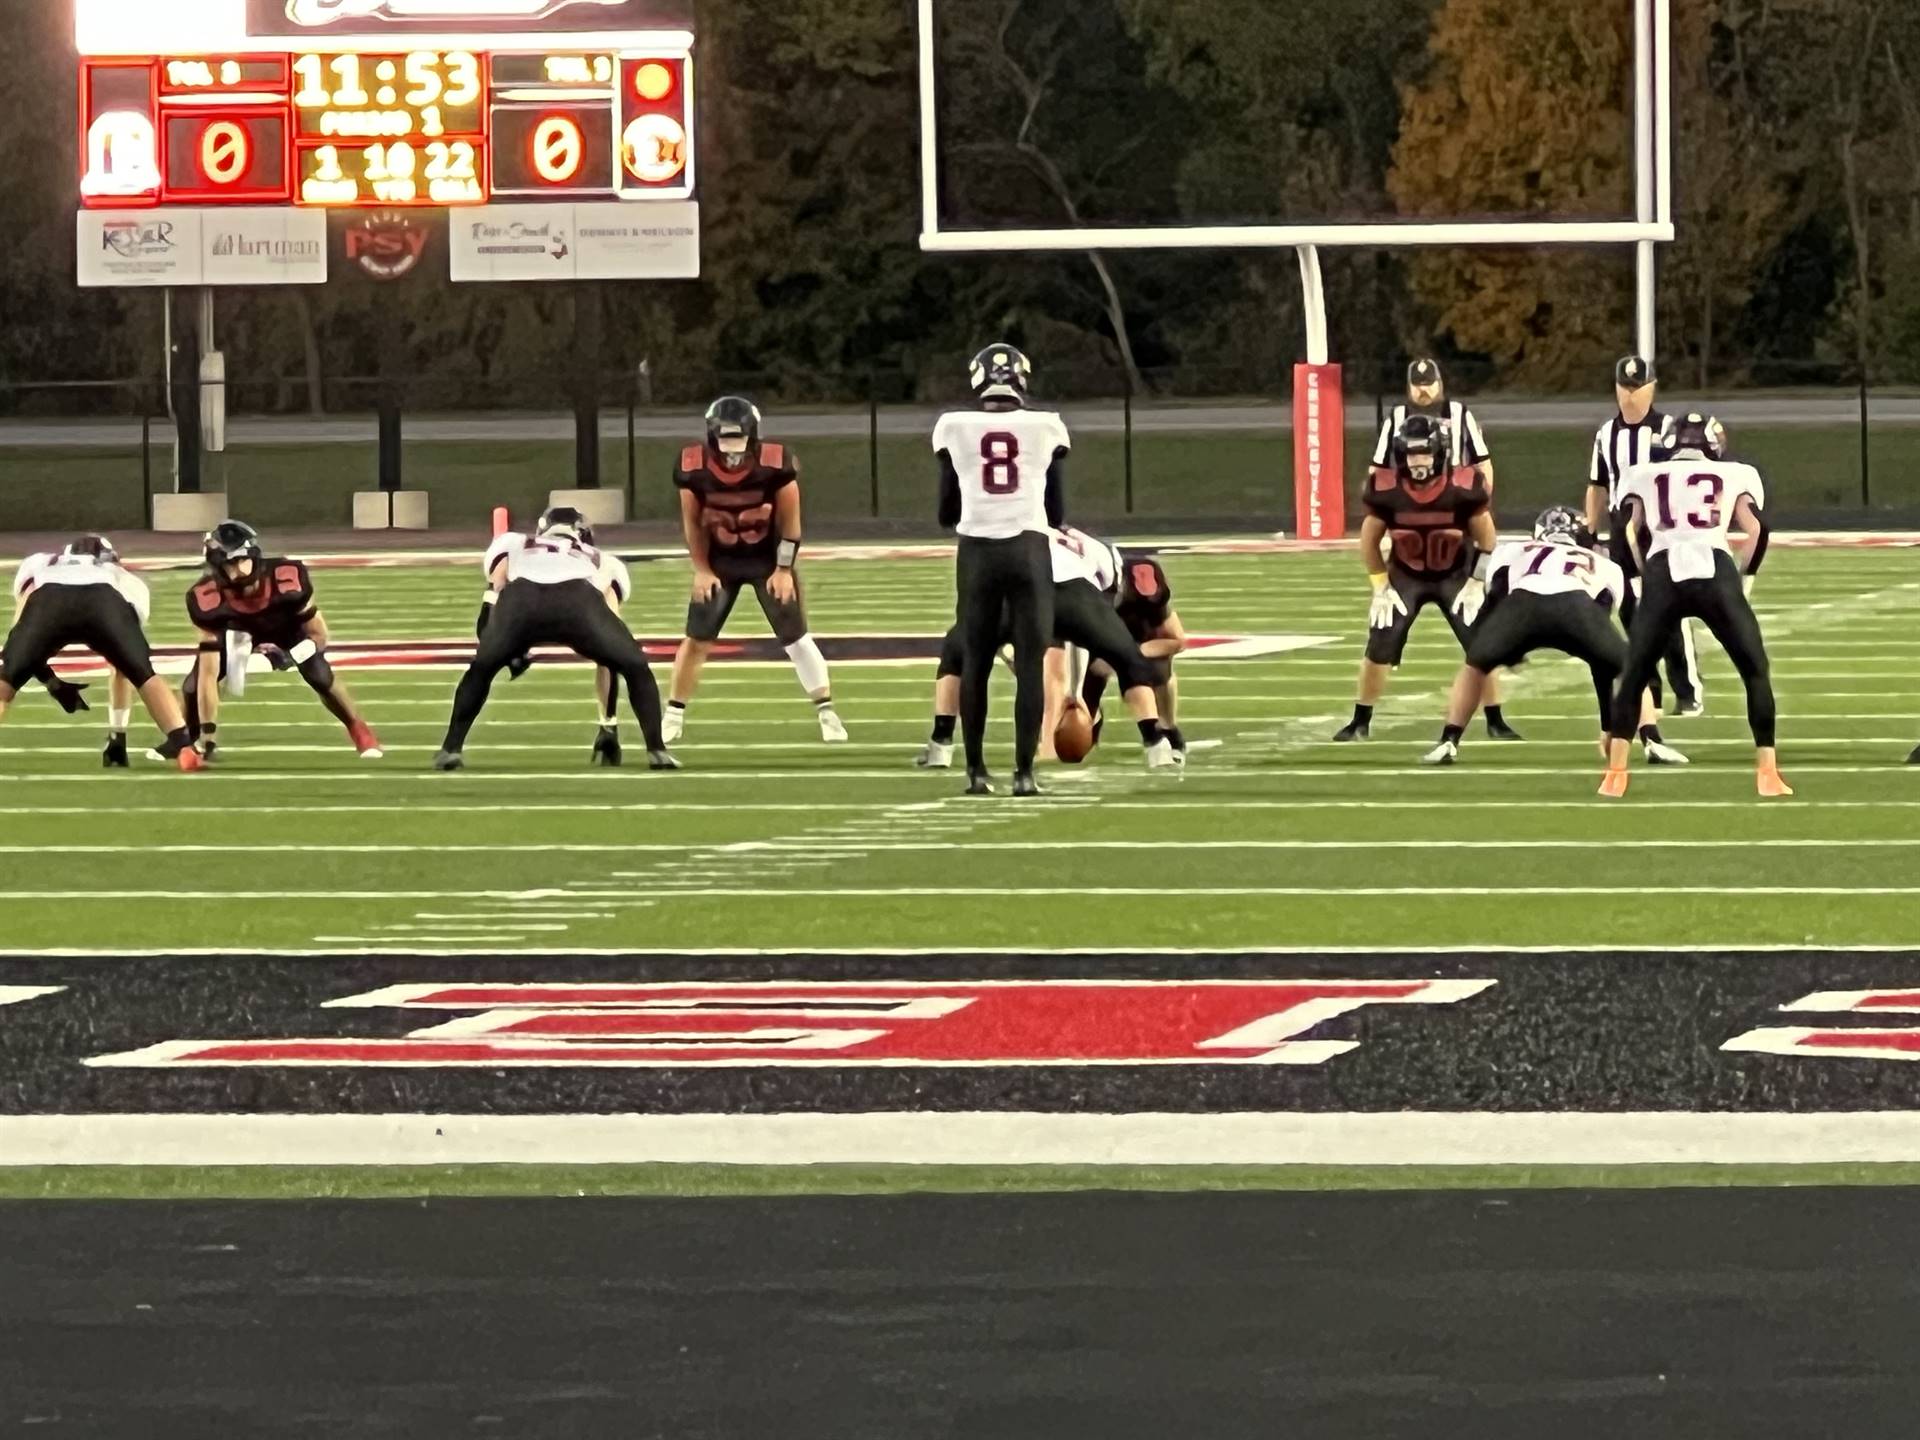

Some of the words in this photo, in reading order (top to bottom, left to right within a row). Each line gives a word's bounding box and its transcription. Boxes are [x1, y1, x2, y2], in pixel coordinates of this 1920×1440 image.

[293, 51, 480, 106] 11:53
[202, 121, 245, 183] 0
[315, 145, 343, 180] 1
[363, 142, 416, 180] 10
[424, 141, 475, 179] 22
[534, 117, 580, 181] 0
[979, 430, 1019, 495] 8
[1654, 473, 1724, 529] 13
[1522, 544, 1596, 585] 72
